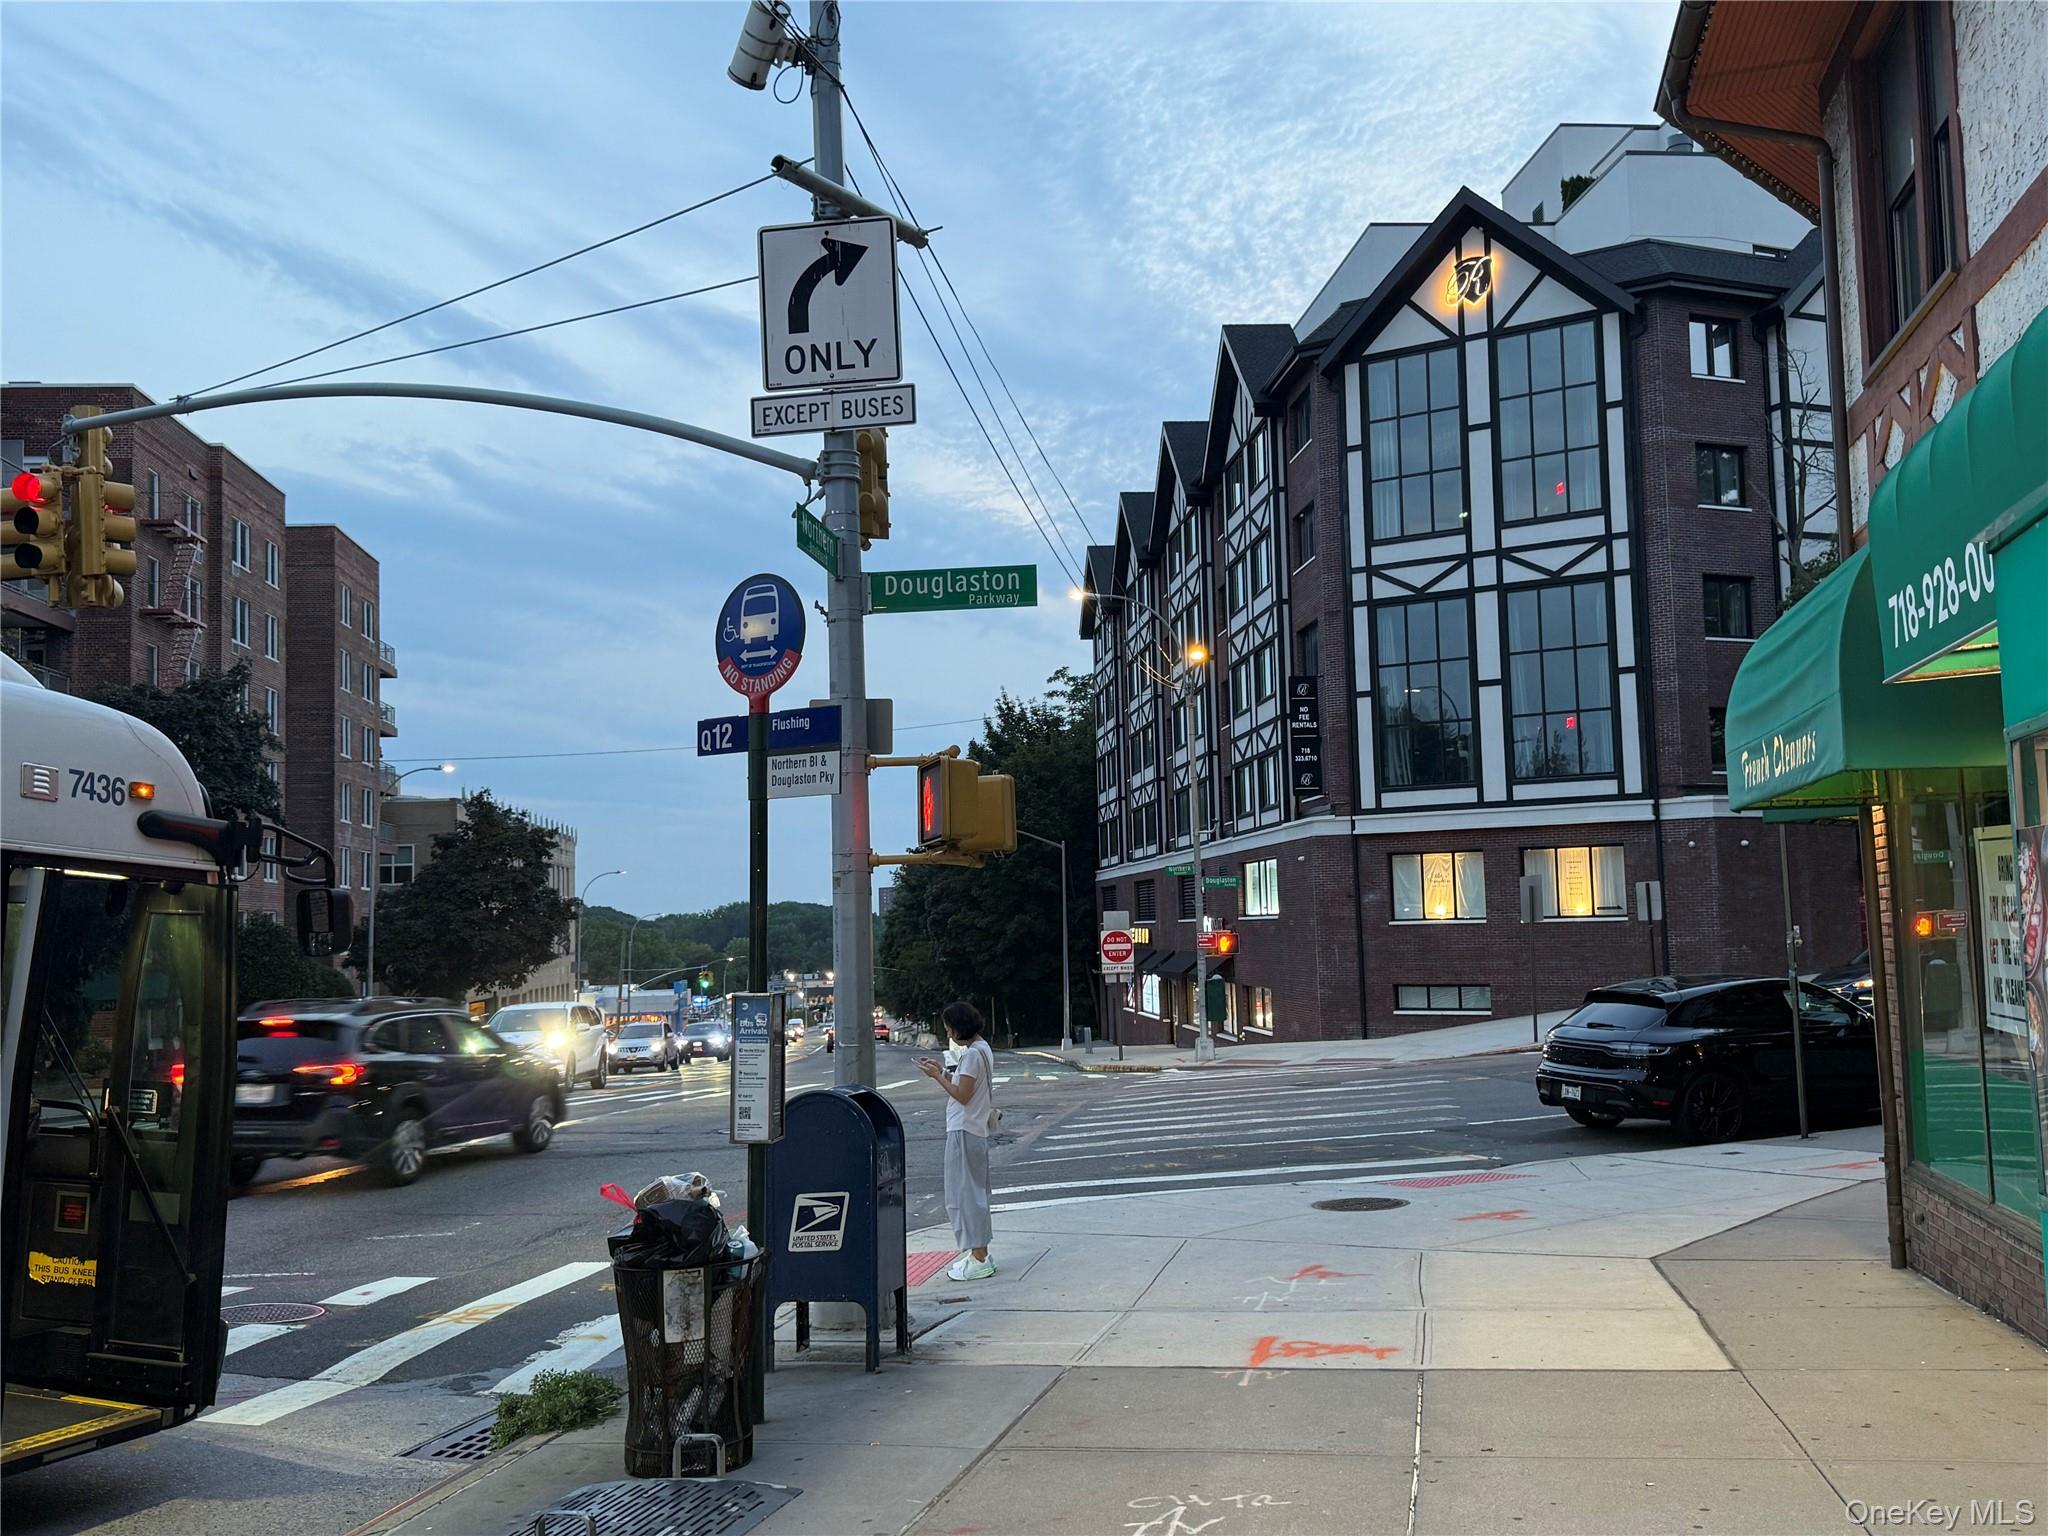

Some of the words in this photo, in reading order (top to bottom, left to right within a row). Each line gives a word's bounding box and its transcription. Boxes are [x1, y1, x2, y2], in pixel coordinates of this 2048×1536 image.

[785, 338, 878, 375] ONLY
[763, 402, 830, 427] EXCEPT
[842, 395, 904, 419] BUSES
[802, 511, 834, 557] Northern
[885, 570, 1020, 599] Douglaston
[969, 593, 1020, 605] Parkway
[723, 664, 739, 684] NO
[741, 658, 793, 692] STANDING
[772, 716, 810, 731] Flushing
[1291, 721, 1318, 729] RENTALS
[1298, 713, 1310, 721] FEE
[701, 723, 733, 752] Q12
[772, 757, 807, 770] Northern
[809, 755, 818, 767] Bl
[820, 754, 827, 767] &
[1741, 740, 1770, 792] French
[1773, 730, 1816, 778] Cleaners
[69, 768, 125, 806] 7436
[772, 773, 817, 787] Douglaston
[819, 771, 835, 785] Pky
[1205, 877, 1237, 885] Douglaston
[740, 1027, 768, 1035] Arrivals
[34, 1264, 51, 1273] THIS
[53, 1266, 70, 1274] BUS
